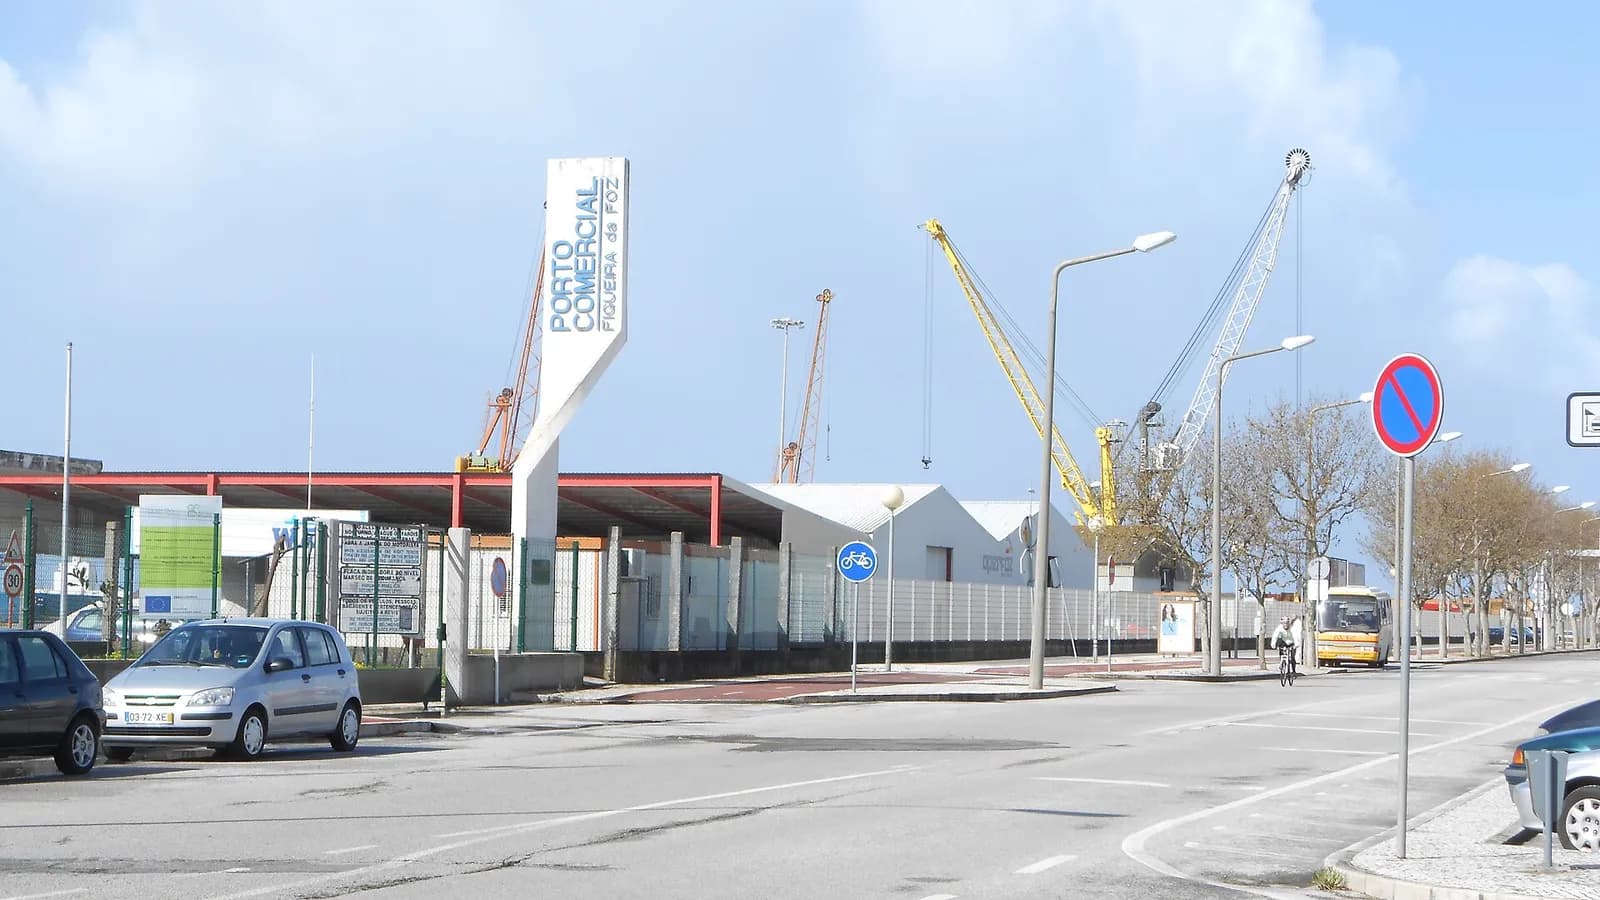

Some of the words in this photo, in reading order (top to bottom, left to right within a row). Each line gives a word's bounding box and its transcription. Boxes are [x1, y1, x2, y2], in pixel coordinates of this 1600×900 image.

[606, 177, 619, 214] FOZ
[573, 176, 598, 332] COMERCIAL
[606, 222, 618, 242] da
[550, 240, 574, 332] PORTO
[602, 252, 617, 331] FIGUEIRA
[7, 574, 20, 588] 30
